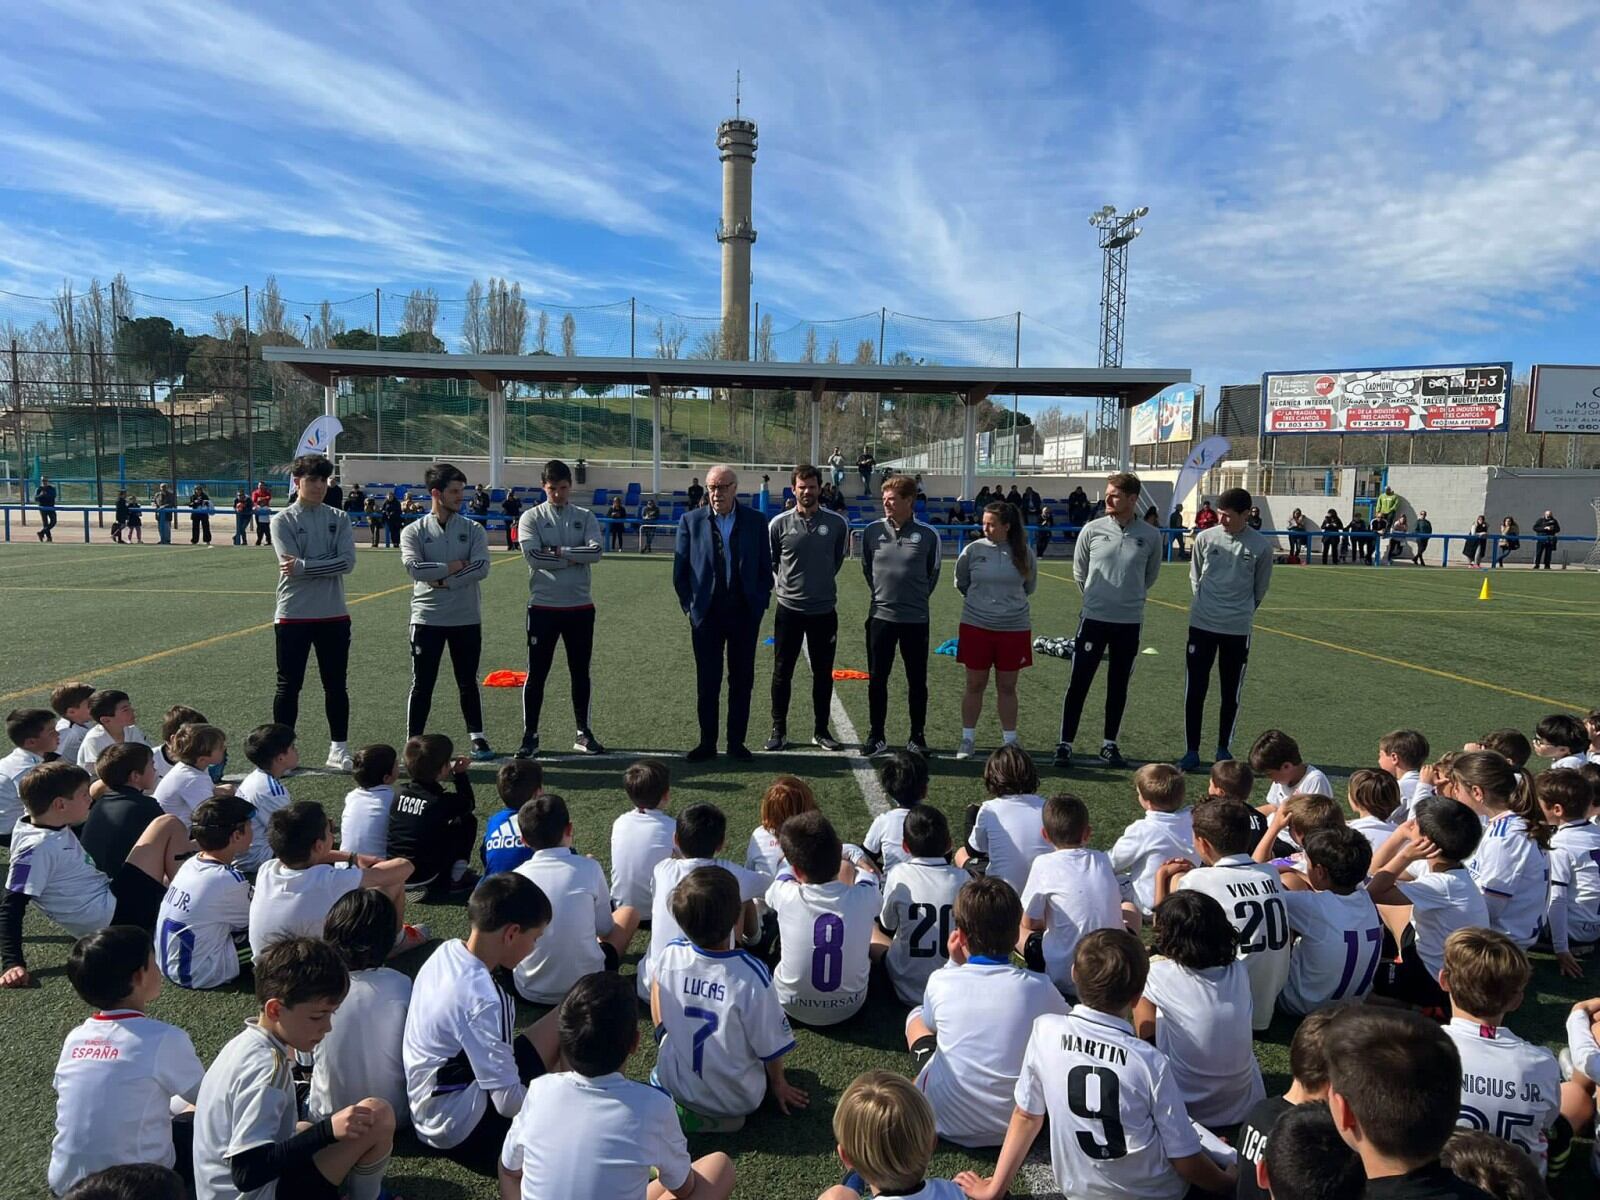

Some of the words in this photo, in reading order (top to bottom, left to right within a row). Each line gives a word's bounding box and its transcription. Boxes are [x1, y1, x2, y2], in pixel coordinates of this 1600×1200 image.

[1226, 882, 1259, 898] VINI
[1233, 897, 1290, 954] 20
[812, 913, 844, 992] 8
[1330, 927, 1382, 1000] 17
[683, 976, 726, 1002] LUCAS
[71, 1045, 119, 1060] ESPAÑA
[684, 1005, 719, 1080] 7
[1060, 1033, 1128, 1067] MARTIN
[1067, 1065, 1128, 1160] 9
[1520, 1082, 1545, 1103] JR.
